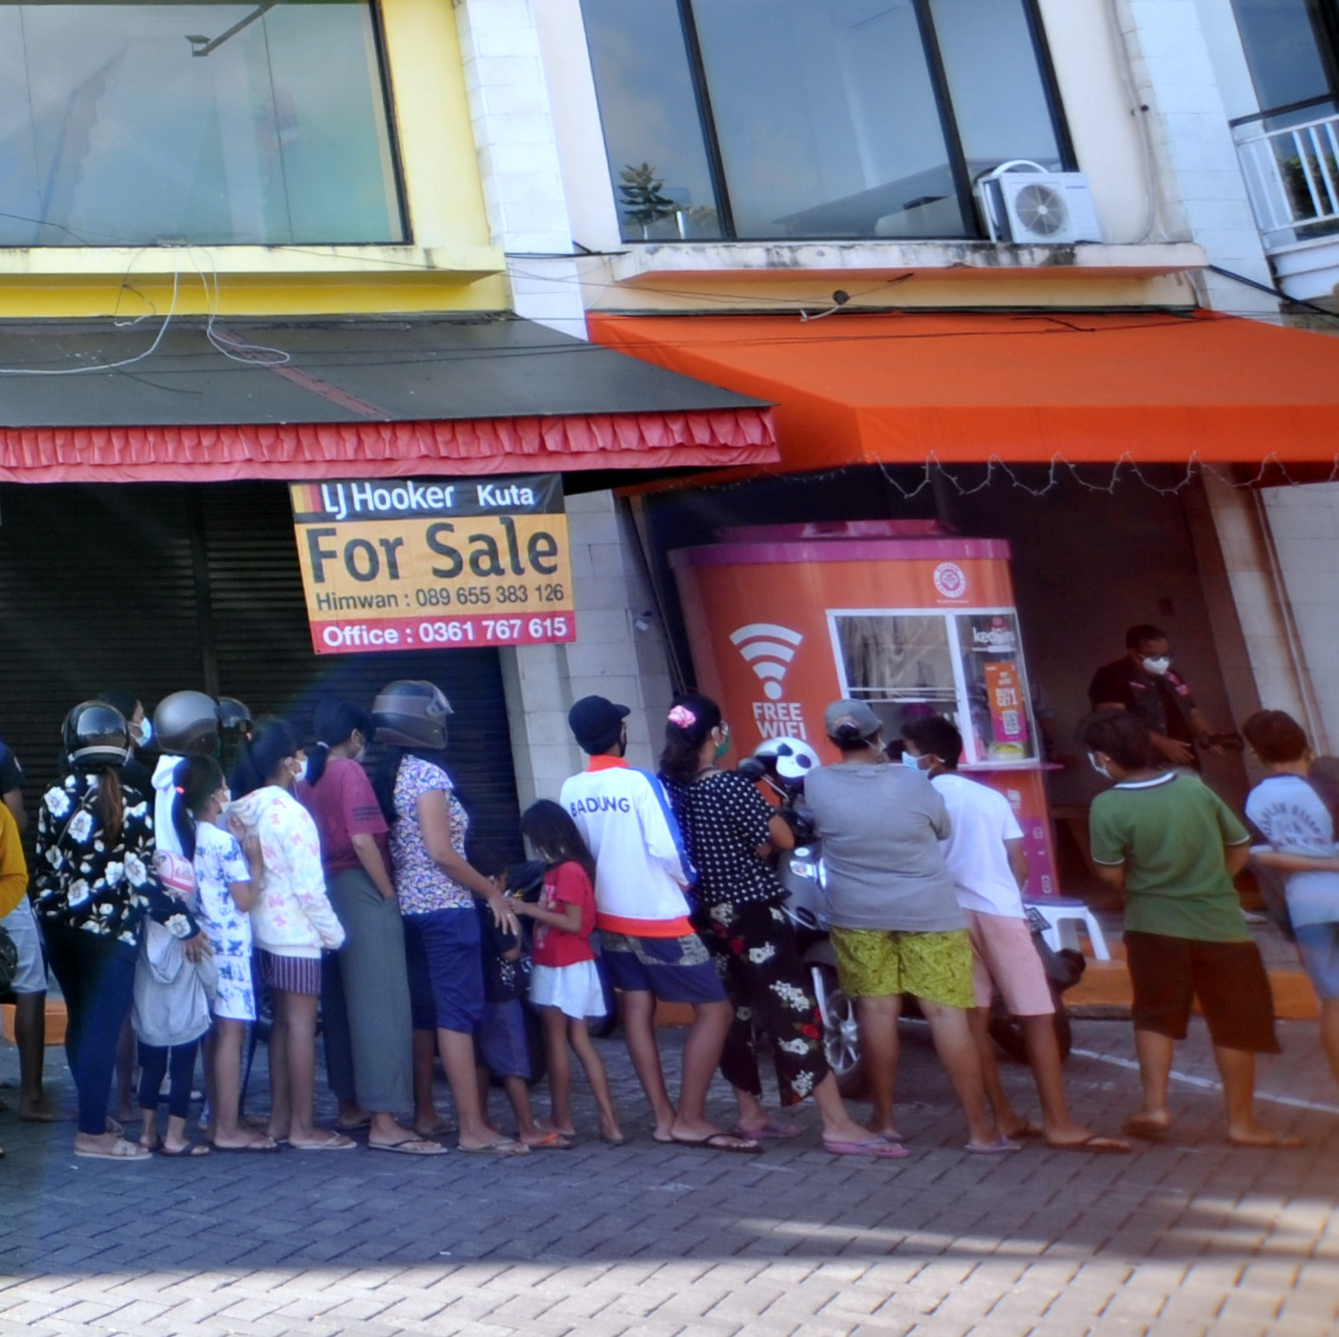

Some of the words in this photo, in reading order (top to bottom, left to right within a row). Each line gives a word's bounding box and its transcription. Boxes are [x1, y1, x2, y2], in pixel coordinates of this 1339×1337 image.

[321, 482, 347, 521] LJ
[351, 480, 455, 512] Hooker
[477, 483, 535, 508] Kuta
[306, 526, 404, 584] For
[426, 516, 559, 580] Sale
[316, 591, 398, 612] Himwan
[416, 588, 452, 608] 089
[456, 586, 492, 606] 655
[496, 585, 529, 604] 383
[535, 583, 565, 603] 126
[323, 624, 400, 648] Office
[418, 620, 474, 643] 0361
[482, 619, 522, 640] 767
[528, 617, 568, 638] 615
[752, 702, 803, 721] FREE
[756, 720, 807, 741] WIFI
[569, 795, 631, 818] BADUNG
